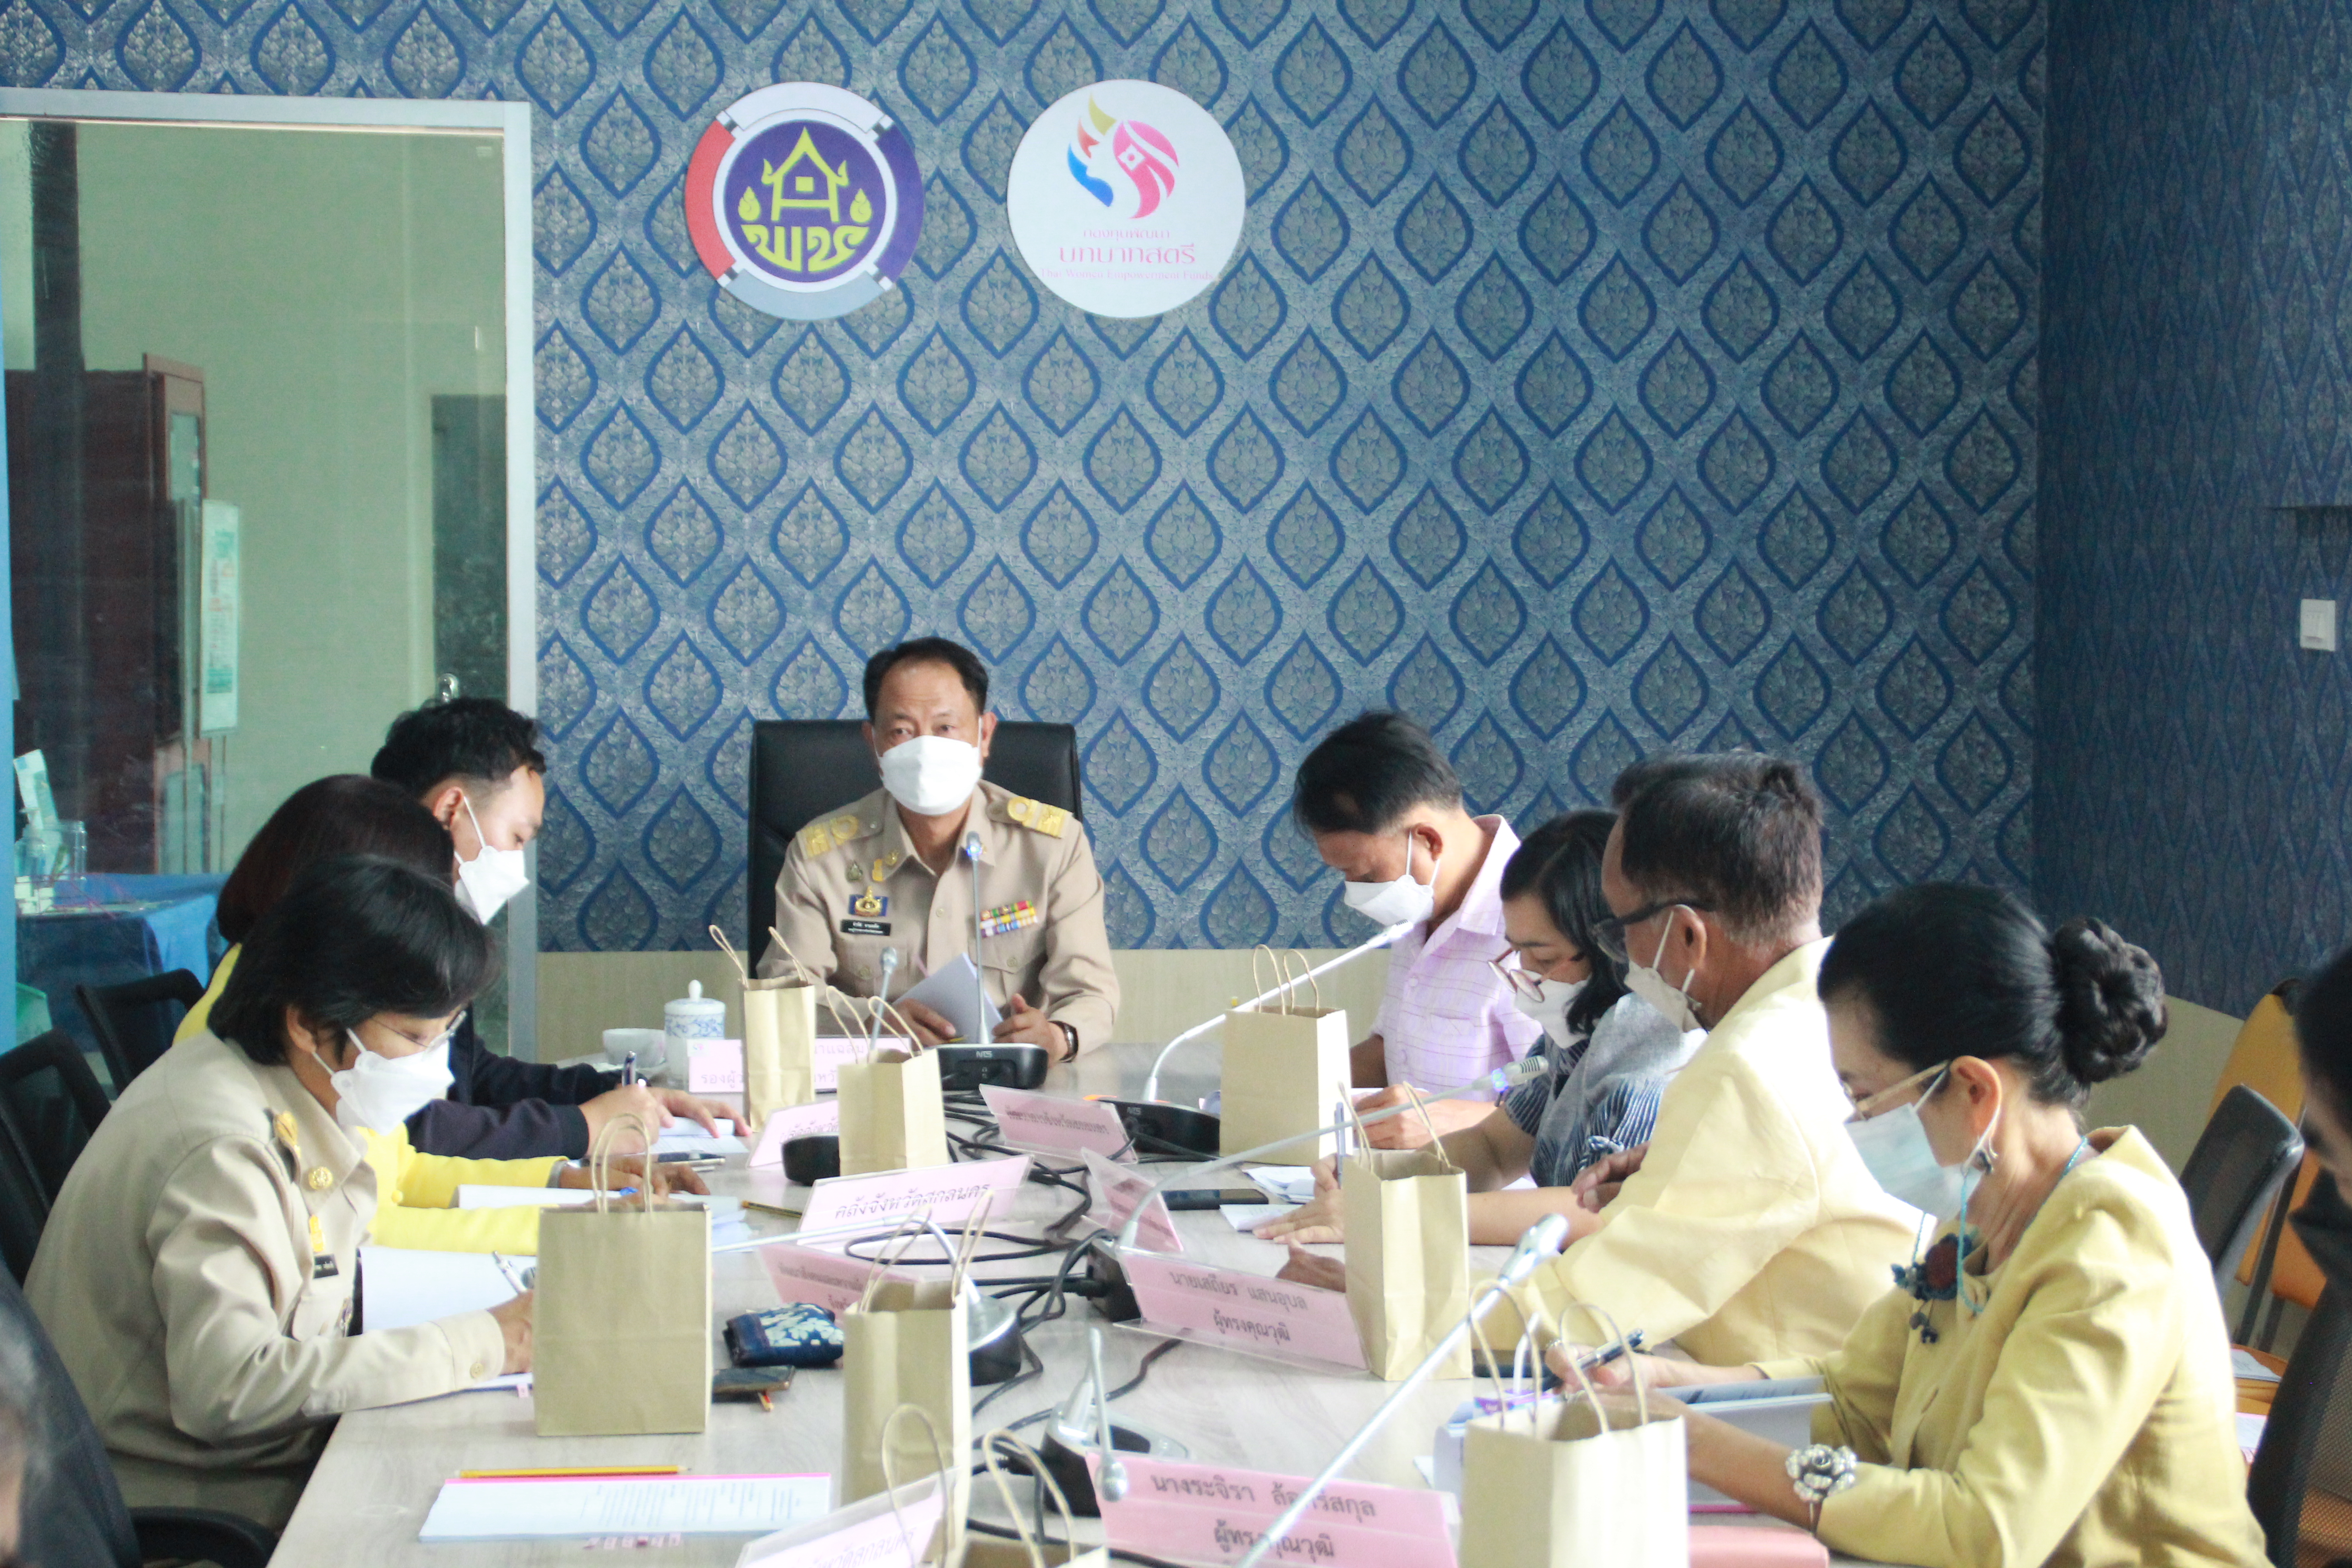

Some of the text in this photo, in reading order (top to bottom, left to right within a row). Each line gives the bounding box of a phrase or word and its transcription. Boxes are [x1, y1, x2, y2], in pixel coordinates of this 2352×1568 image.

[1083, 228, 1171, 241] กองทุนพัฒนา
[1059, 243, 1196, 264] บทบาทสตรี
[1041, 269, 1214, 280] Thai Women Empowerment Funds
[1213, 1308, 1291, 1345] ผู้ทรงคุณวุฒิ
